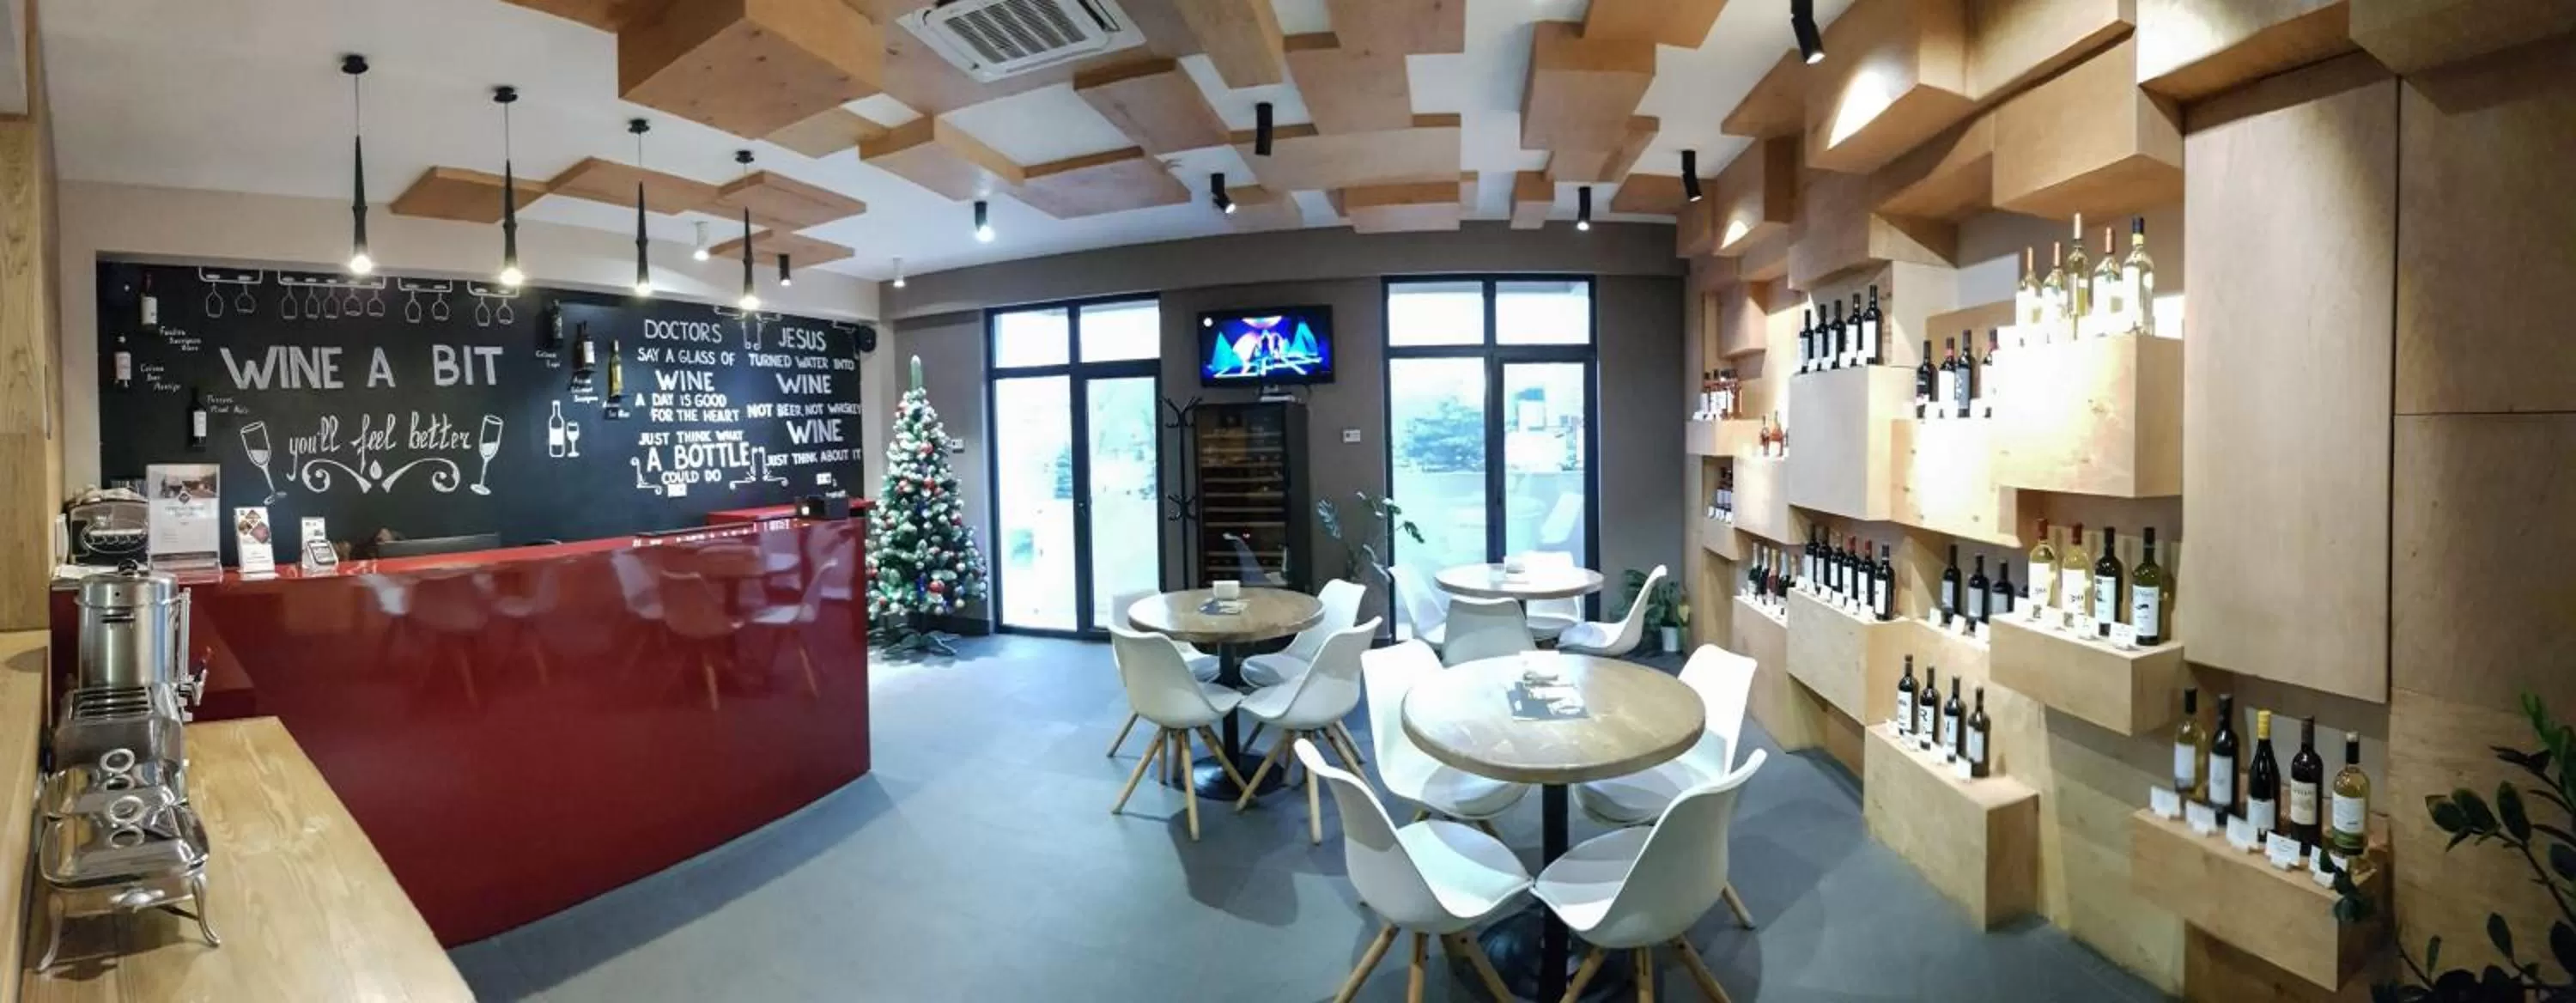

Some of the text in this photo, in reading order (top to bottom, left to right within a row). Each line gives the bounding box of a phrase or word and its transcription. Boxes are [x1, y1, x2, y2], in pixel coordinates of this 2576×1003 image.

[644, 319, 722, 343] DOCTORS
[778, 327, 827, 351] JESUS
[220, 344, 503, 389] WINE A BIT
[637, 347, 736, 366] SAY A GLASS OF
[748, 353, 792, 368] TURNED
[795, 356, 829, 369] WATER
[654, 369, 715, 392] WINE
[775, 373, 832, 394] WINE
[635, 392, 646, 407] A
[652, 392, 674, 406] DAY
[679, 393, 691, 407] IS
[694, 393, 727, 408] GOOD
[650, 408, 740, 422] FOR THE HEART
[746, 404, 773, 418] NOT
[805, 404, 823, 415] NOT
[350, 414, 397, 473] feel
[408, 411, 471, 450] better
[639, 430, 744, 446] JUST THINK WHAT
[786, 419, 844, 445] WINE
[647, 441, 750, 472] A BOTTLE
[767, 448, 861, 466] JUST THINK ABOUT IT
[660, 469, 722, 485] COULD DO
